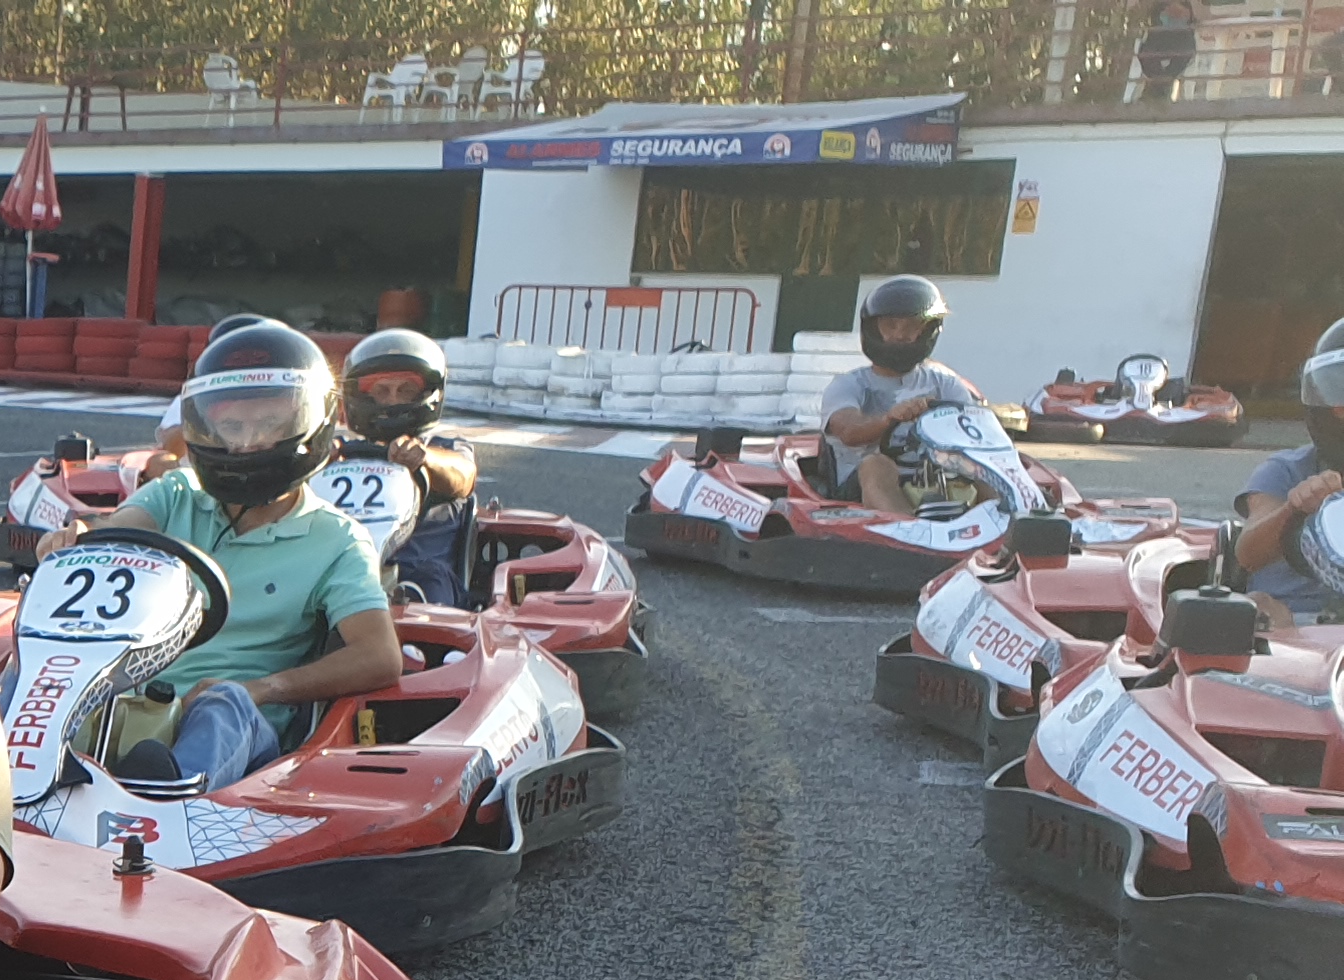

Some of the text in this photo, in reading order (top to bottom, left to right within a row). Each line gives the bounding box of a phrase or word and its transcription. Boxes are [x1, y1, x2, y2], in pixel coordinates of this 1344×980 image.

[610, 138, 742, 158] SEGURANÇA
[888, 142, 953, 166] SEGURANÇA
[210, 372, 274, 386] EUROINDY
[957, 414, 983, 441] 6
[331, 474, 385, 508] 22
[694, 485, 762, 527] FERBERTO
[54, 555, 163, 569] EUROINDY
[49, 567, 136, 620] 23
[967, 615, 1039, 676] FERBER
[7, 655, 81, 770] FERBERTO
[1100, 729, 1204, 825] FERBER
